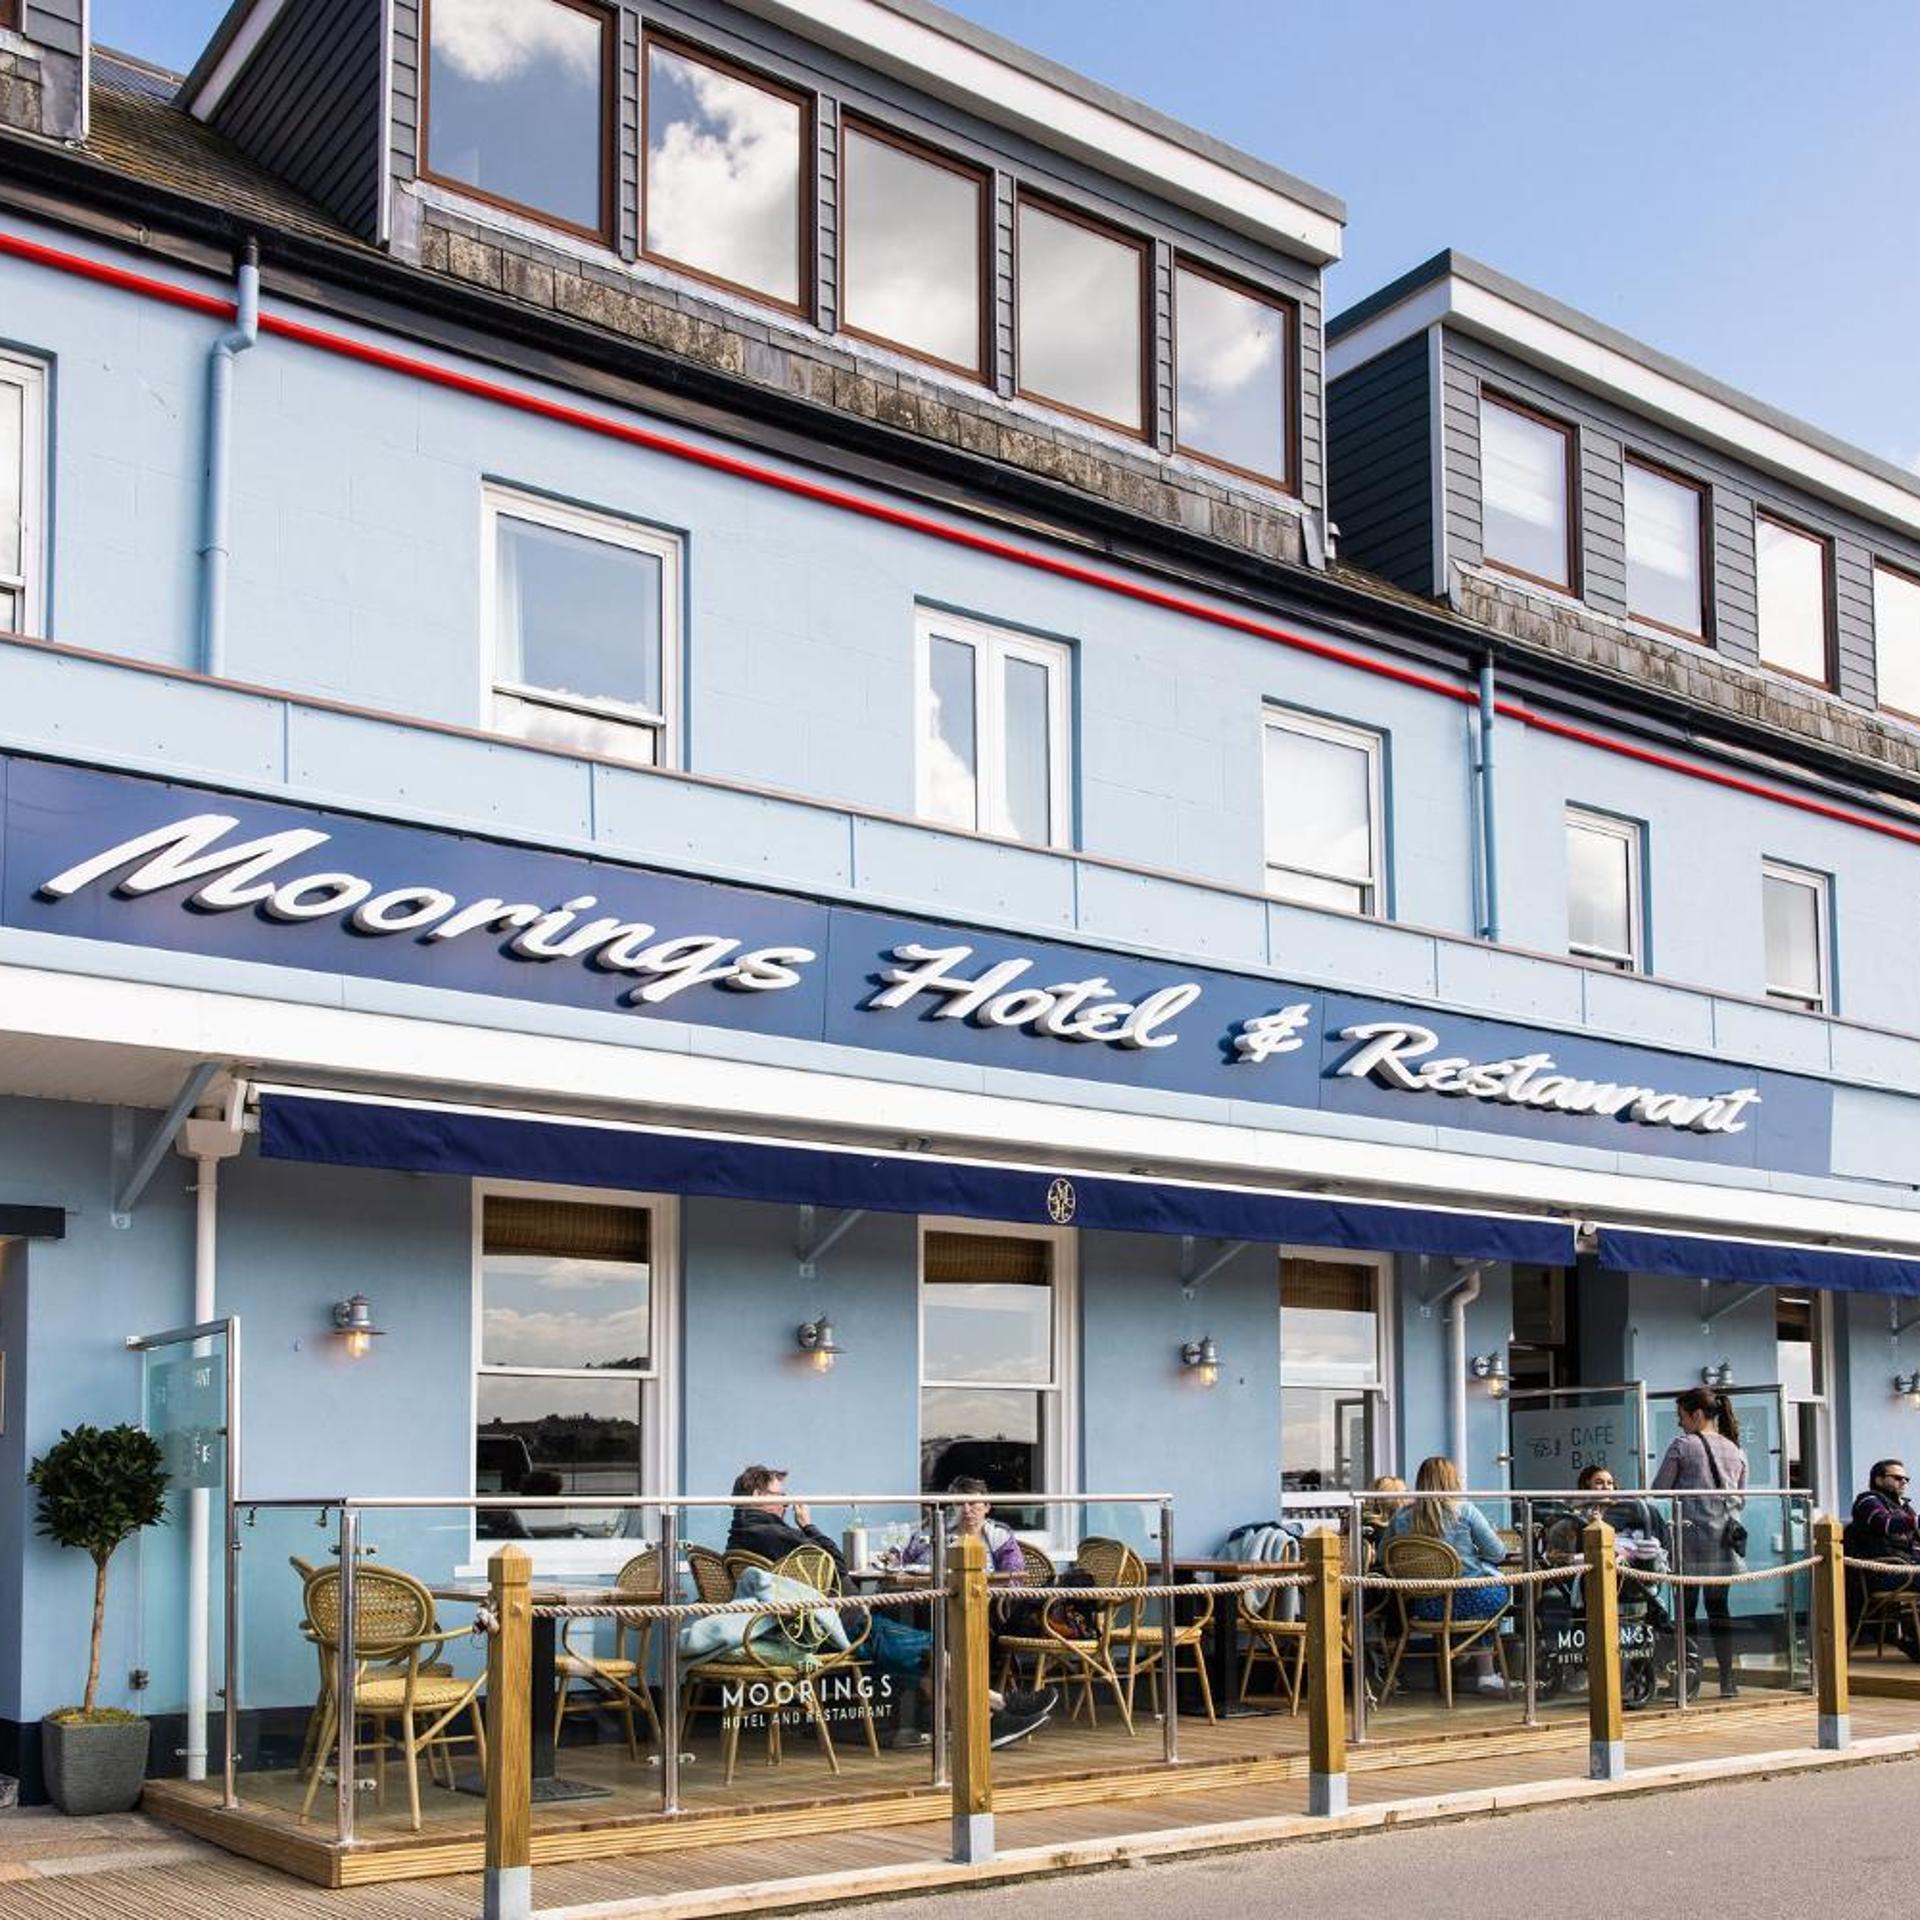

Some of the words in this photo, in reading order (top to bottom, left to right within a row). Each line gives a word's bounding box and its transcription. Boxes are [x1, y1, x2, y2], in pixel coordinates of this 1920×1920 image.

[39, 813, 817, 1003] Moorings
[867, 943, 1202, 1049] Hotel
[1231, 1002, 1312, 1063] &
[1335, 1021, 1761, 1135] Restaurant
[1557, 1624, 1655, 1650] MONGS
[722, 1673, 893, 1709] MOORINGS
[722, 1715, 766, 1730] HOTEL
[771, 1710, 801, 1726] AND
[805, 1703, 893, 1723] RESTAURANT
